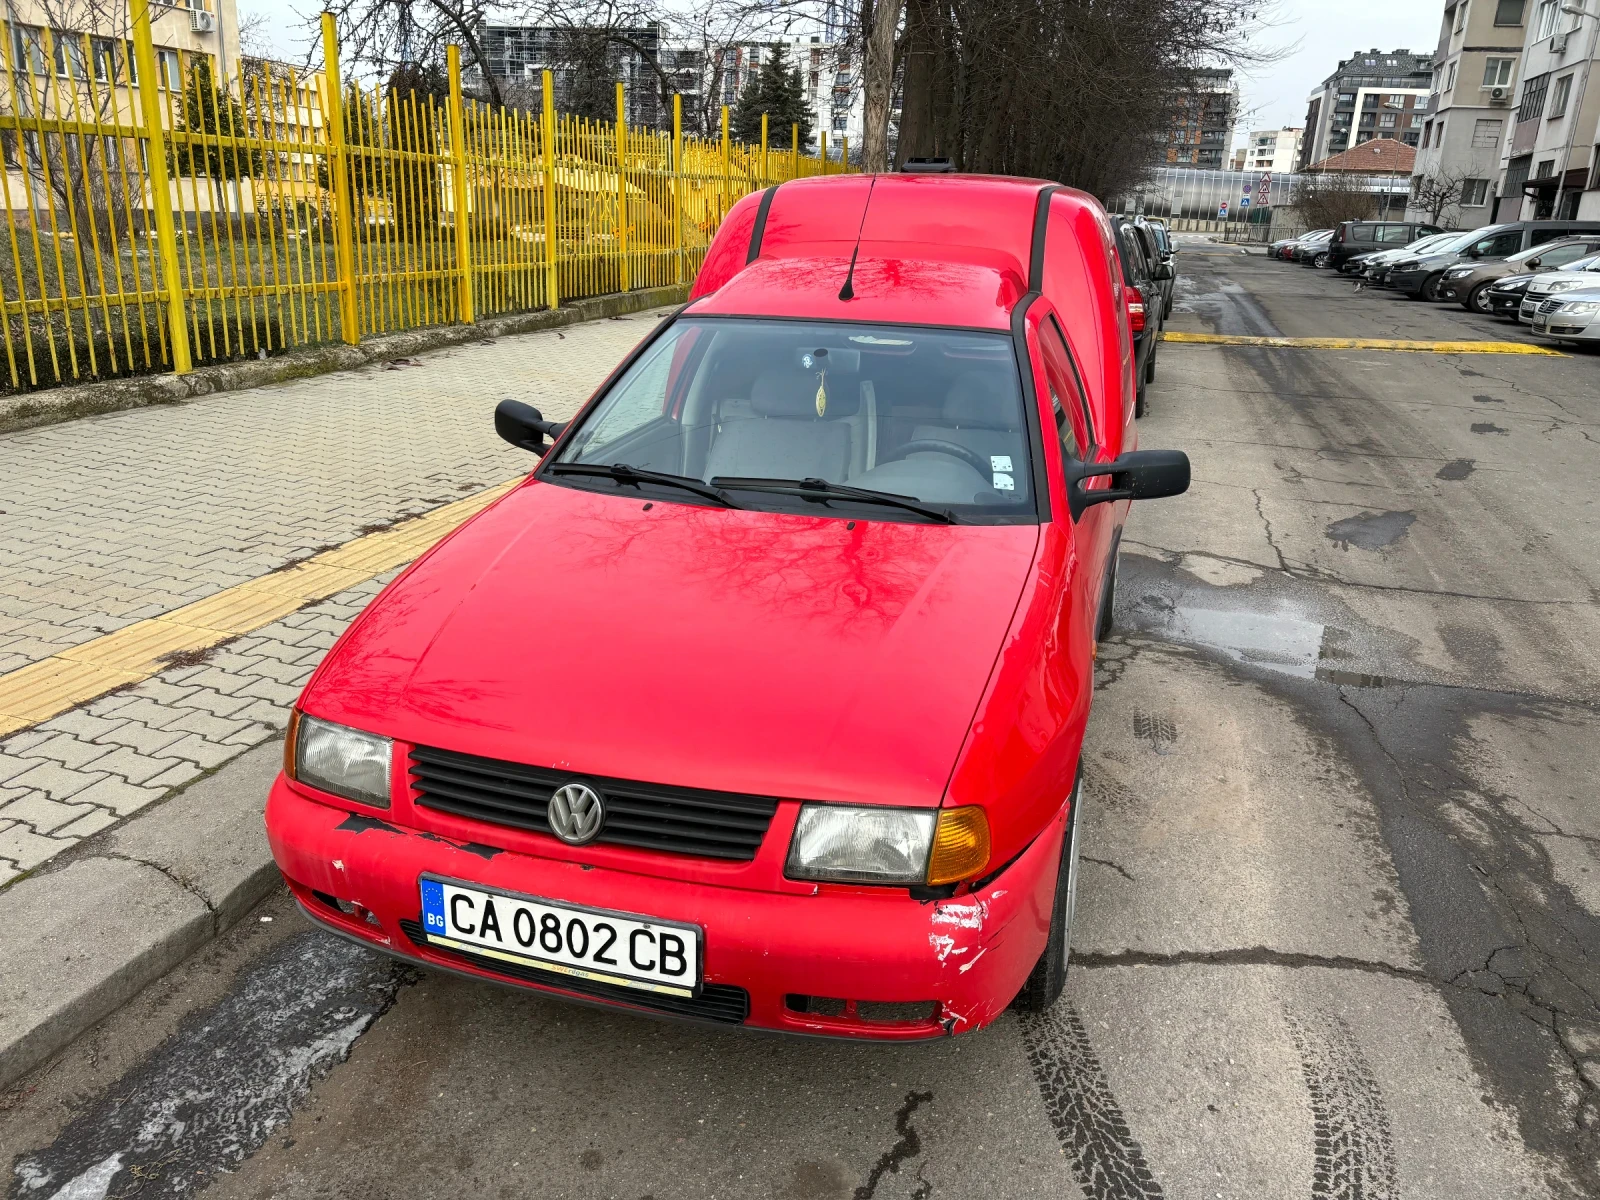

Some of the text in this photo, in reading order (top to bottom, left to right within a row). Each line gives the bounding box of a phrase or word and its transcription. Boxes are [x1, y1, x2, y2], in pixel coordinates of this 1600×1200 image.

[549, 784, 601, 841] VW
[427, 912, 444, 928] BG
[450, 893, 687, 977] CA 0802 CB
